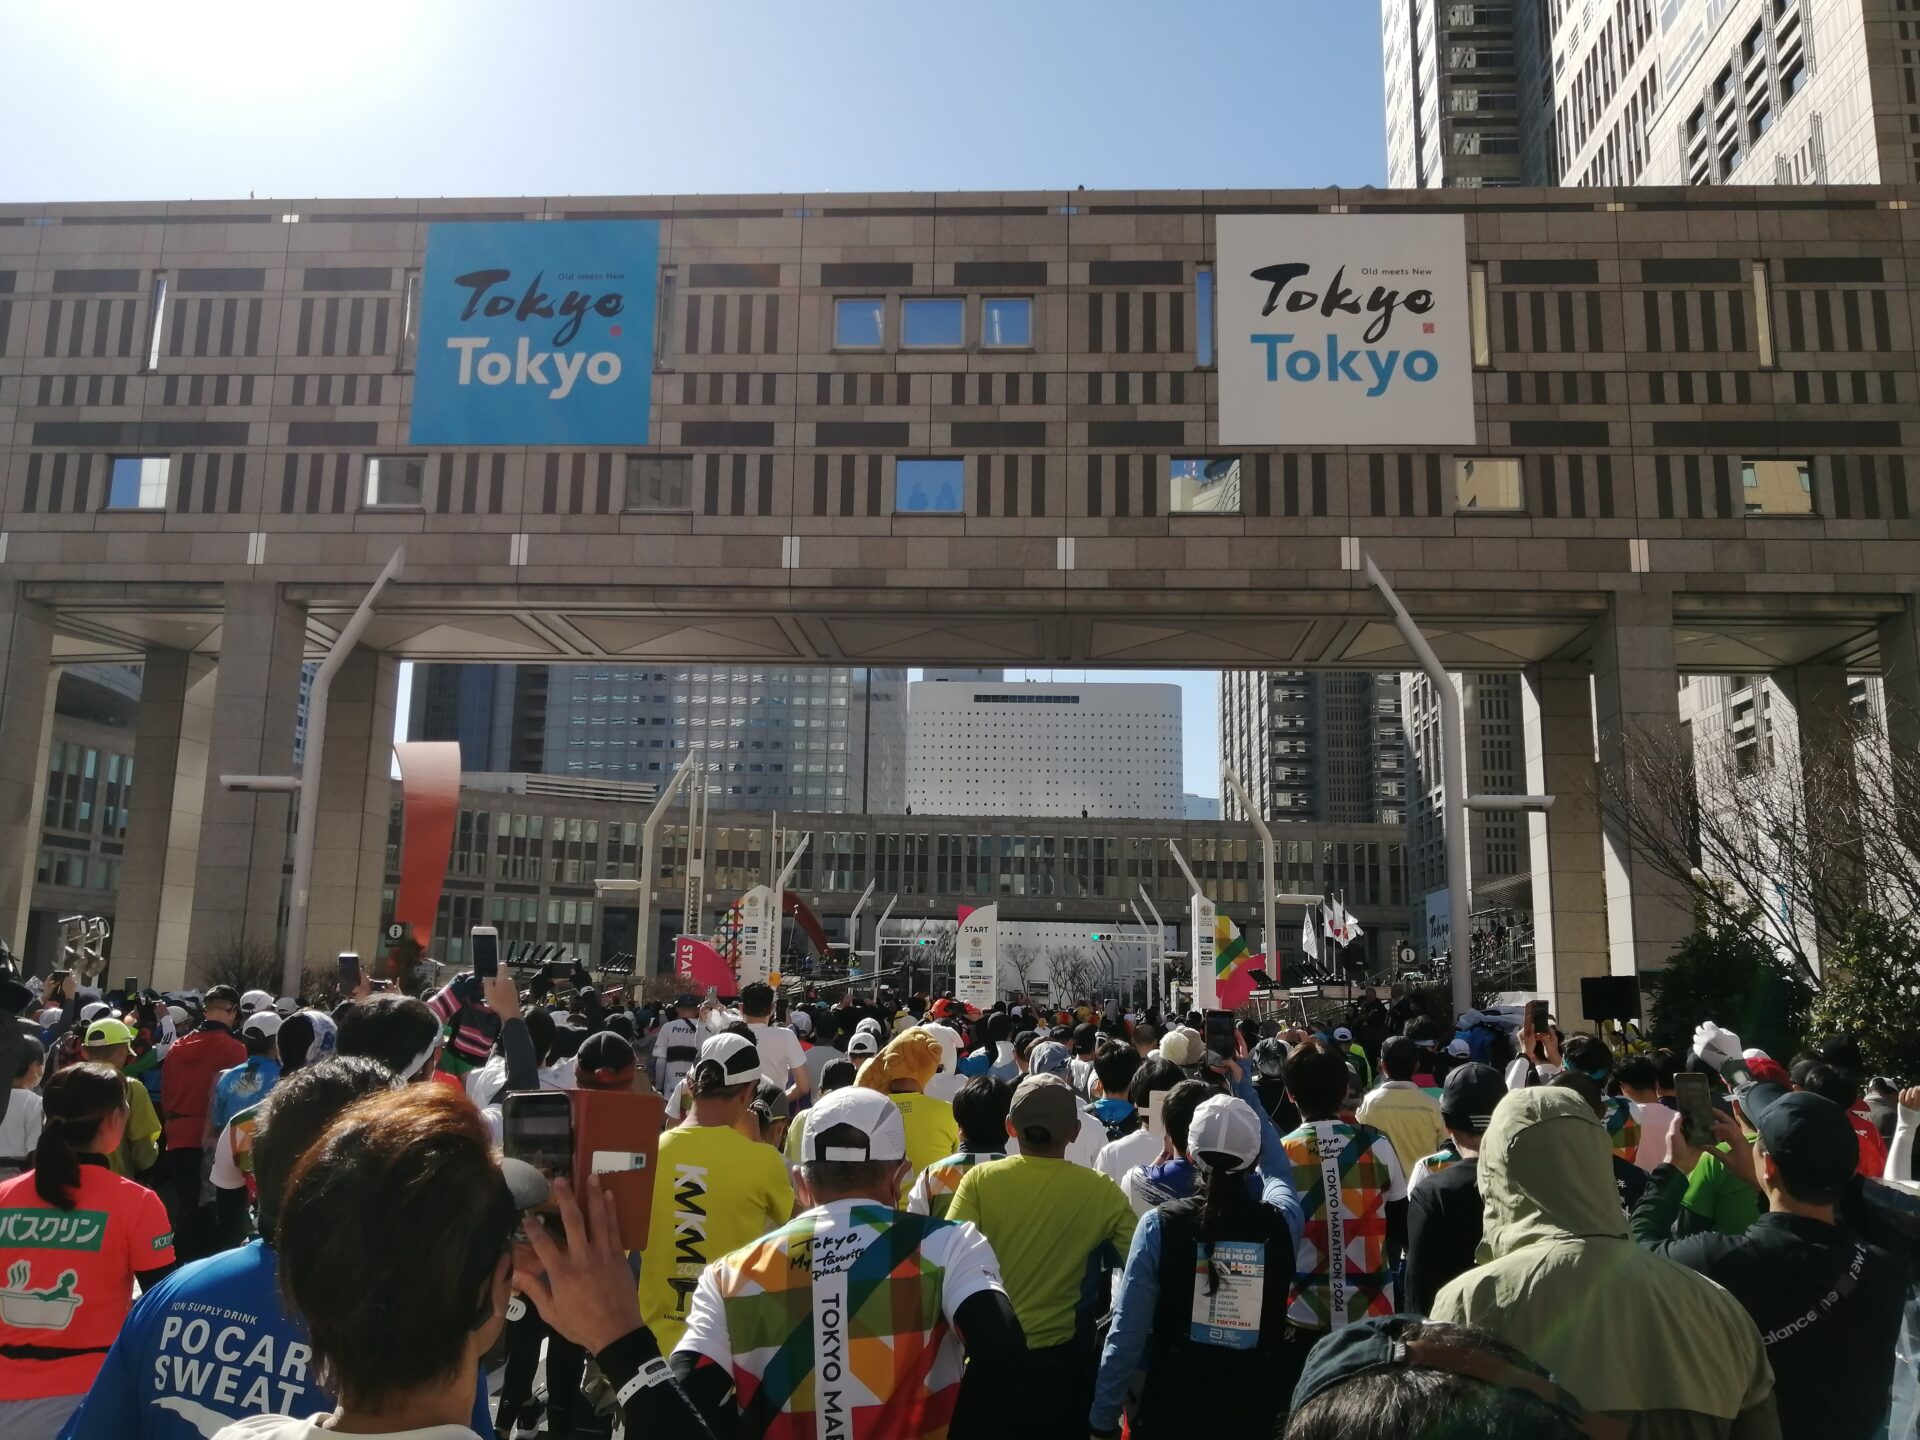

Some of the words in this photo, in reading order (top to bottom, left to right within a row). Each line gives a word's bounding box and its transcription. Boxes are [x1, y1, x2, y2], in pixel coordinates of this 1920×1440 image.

[558, 272, 574, 281] Old
[576, 273, 603, 281] meets
[606, 272, 625, 280] New
[1361, 267, 1378, 276] Old
[1381, 267, 1409, 276] meets
[1412, 267, 1433, 276] New
[454, 268, 625, 348] Tokyo
[1250, 263, 1436, 344] Tokyo
[447, 336, 622, 400] Tokyo
[1250, 333, 1439, 397] Tokyo
[964, 926, 989, 934] START
[681, 944, 694, 980] STAR
[672, 1026, 696, 1035] Perso
[1326, 1168, 1339, 1209] TOKYO
[0, 1213, 100, 1244] バスクリン
[1330, 1211, 1343, 1280] MARATHON
[676, 1263, 702, 1276] 202
[791, 1254, 811, 1273] My
[1232, 1252, 1244, 1261] ME
[1244, 1253, 1258, 1262] ON
[171, 1302, 186, 1311] ION
[187, 1302, 223, 1316] SUPPLY
[223, 1309, 258, 1326] DRINK
[1333, 1283, 1344, 1312] 2024
[821, 1293, 842, 1382] TOKYO
[1762, 1310, 1818, 1345] alance
[159, 1316, 313, 1382] POCAR
[154, 1354, 305, 1416] SWEAT
